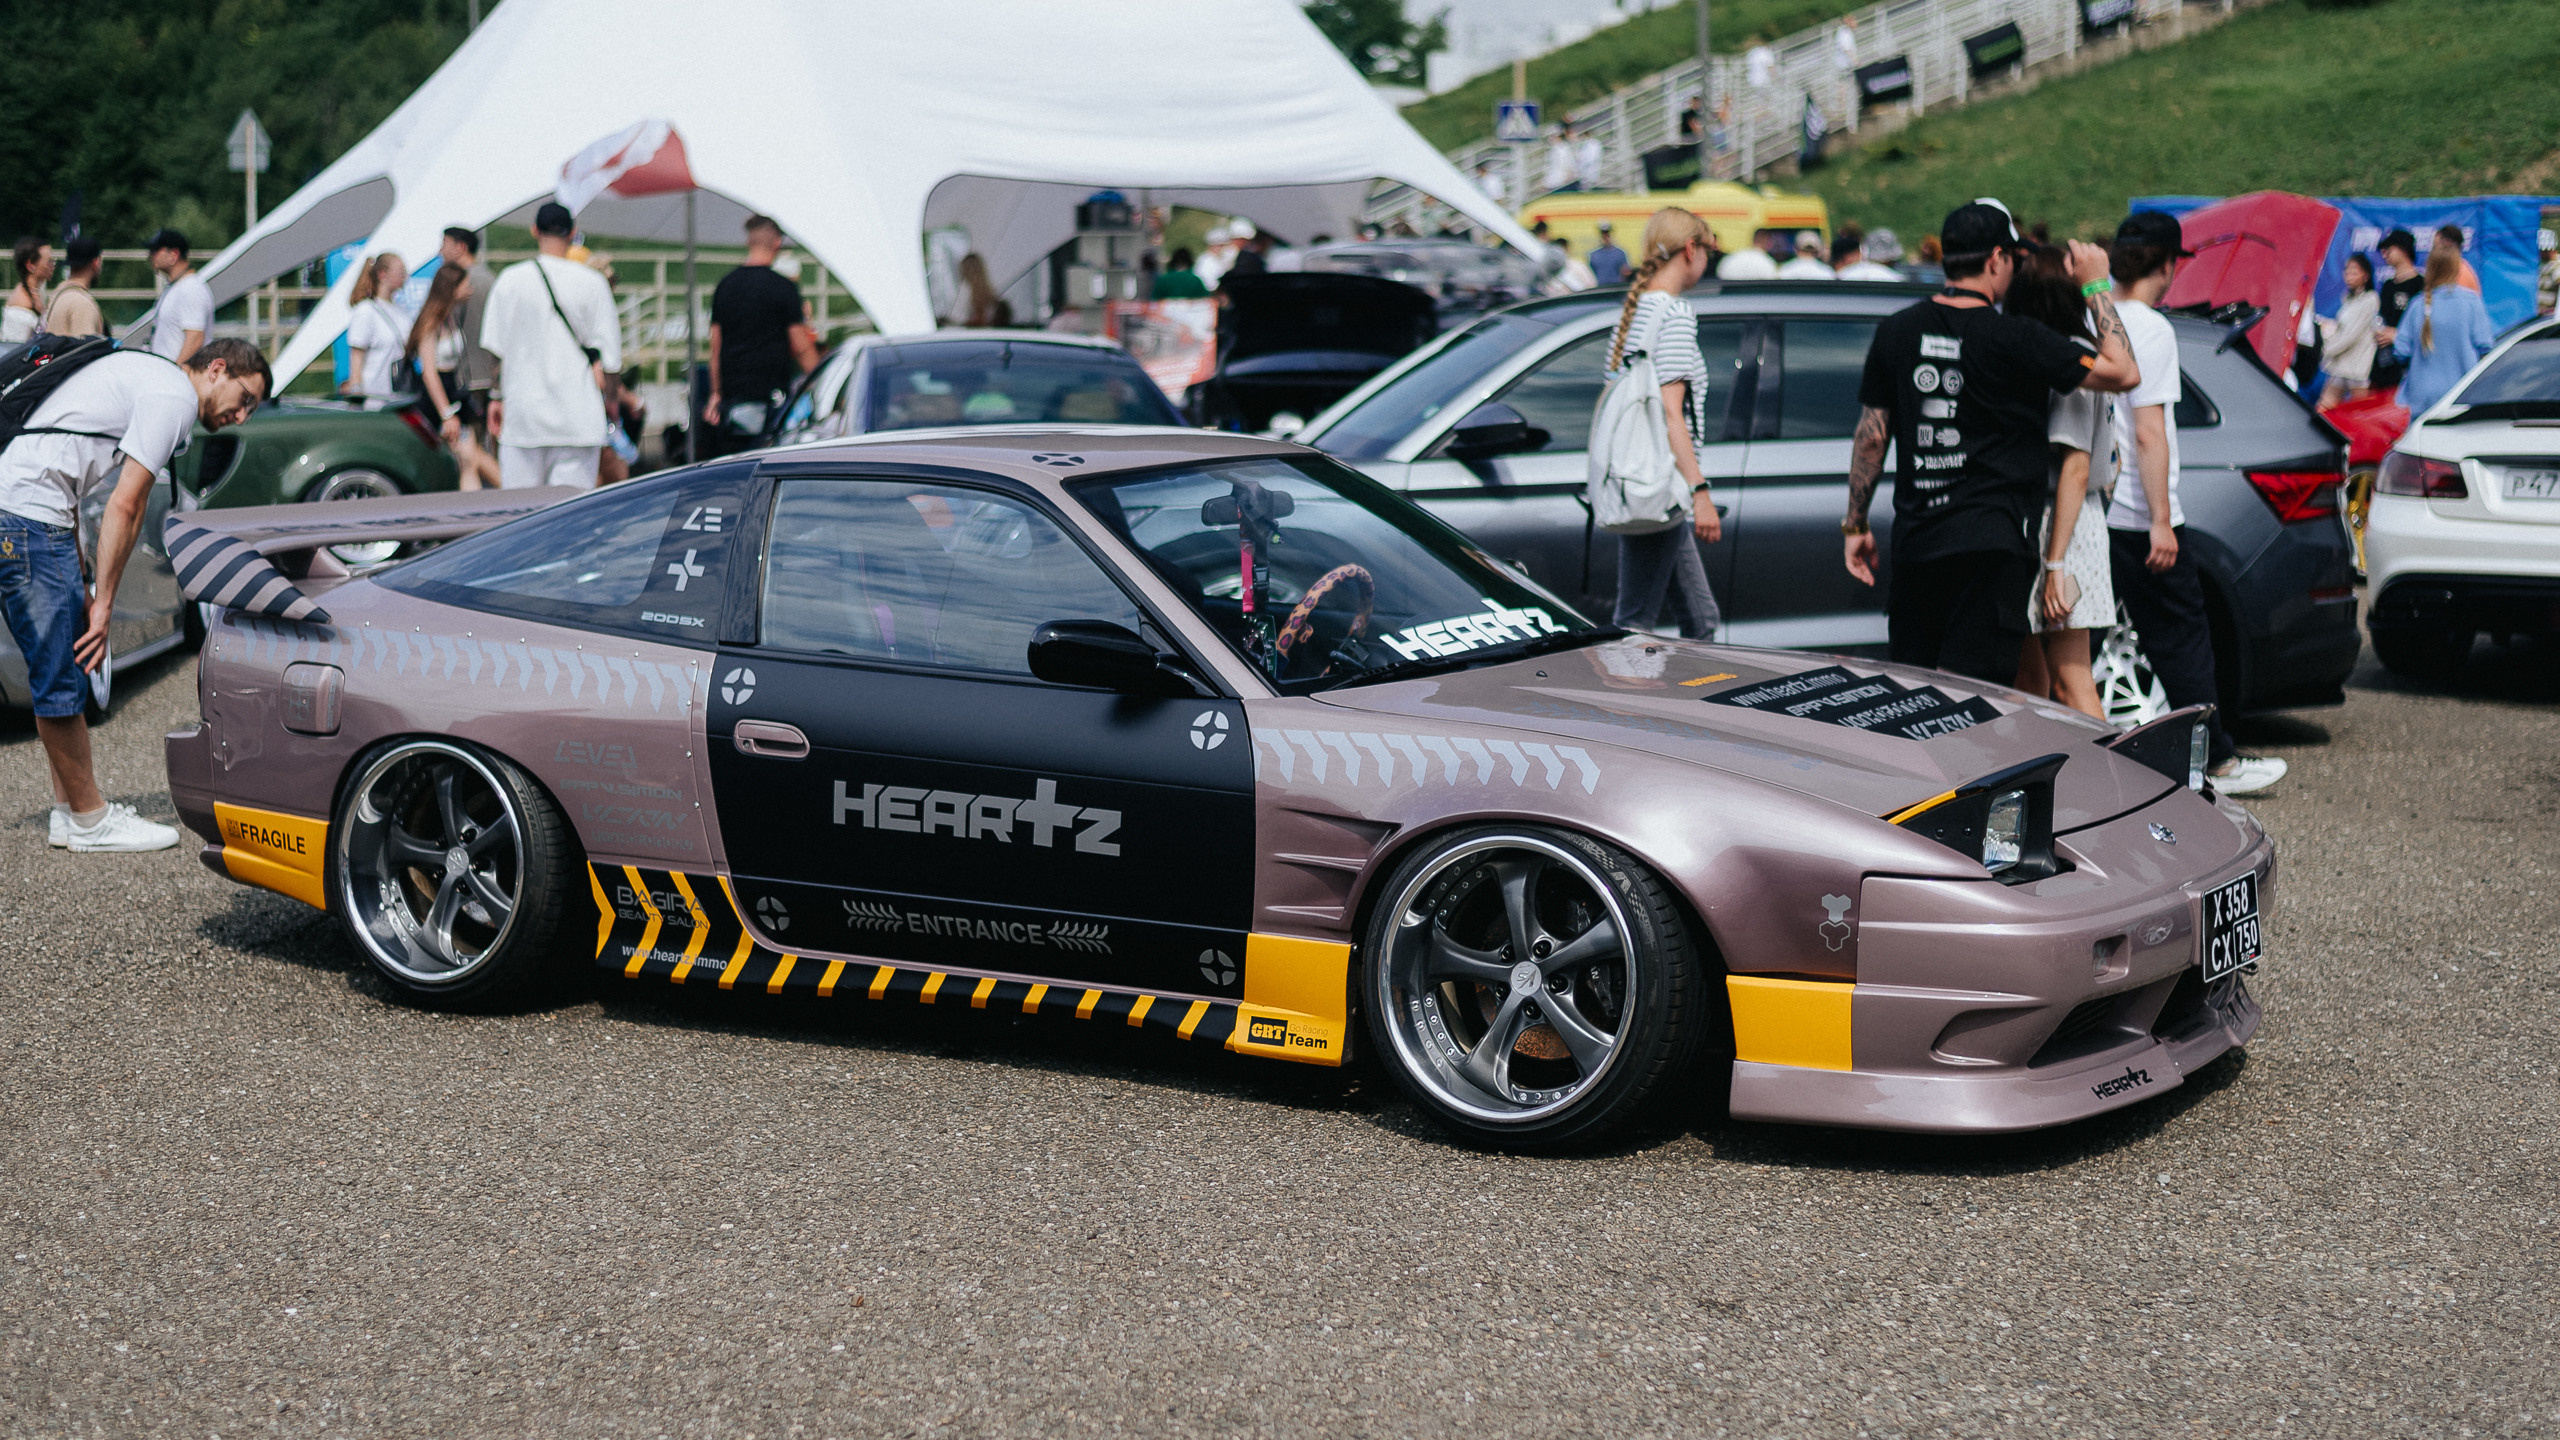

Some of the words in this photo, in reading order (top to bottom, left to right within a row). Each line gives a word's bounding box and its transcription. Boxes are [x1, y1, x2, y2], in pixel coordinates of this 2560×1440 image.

[641, 610, 705, 627] 200SX
[1379, 598, 1569, 661] HEARTZ
[1730, 673, 1848, 706] www.heartz.immo
[833, 778, 1122, 857] HEARTZ
[240, 822, 306, 855] FRAGILE
[617, 886, 707, 915] BAGIRA
[2225, 880, 2249, 921] 358
[618, 909, 665, 923] BEAUTY
[668, 915, 709, 930] SALON
[908, 912, 1045, 945] ENTRANCE
[2236, 919, 2258, 953] 750
[622, 945, 728, 970] www.heartz.immo
[1251, 1023, 1285, 1040] GRT
[1288, 1033, 1327, 1049] Team
[1302, 1025, 1328, 1037] Racing
[2091, 1066, 2153, 1100] HEARTZ
